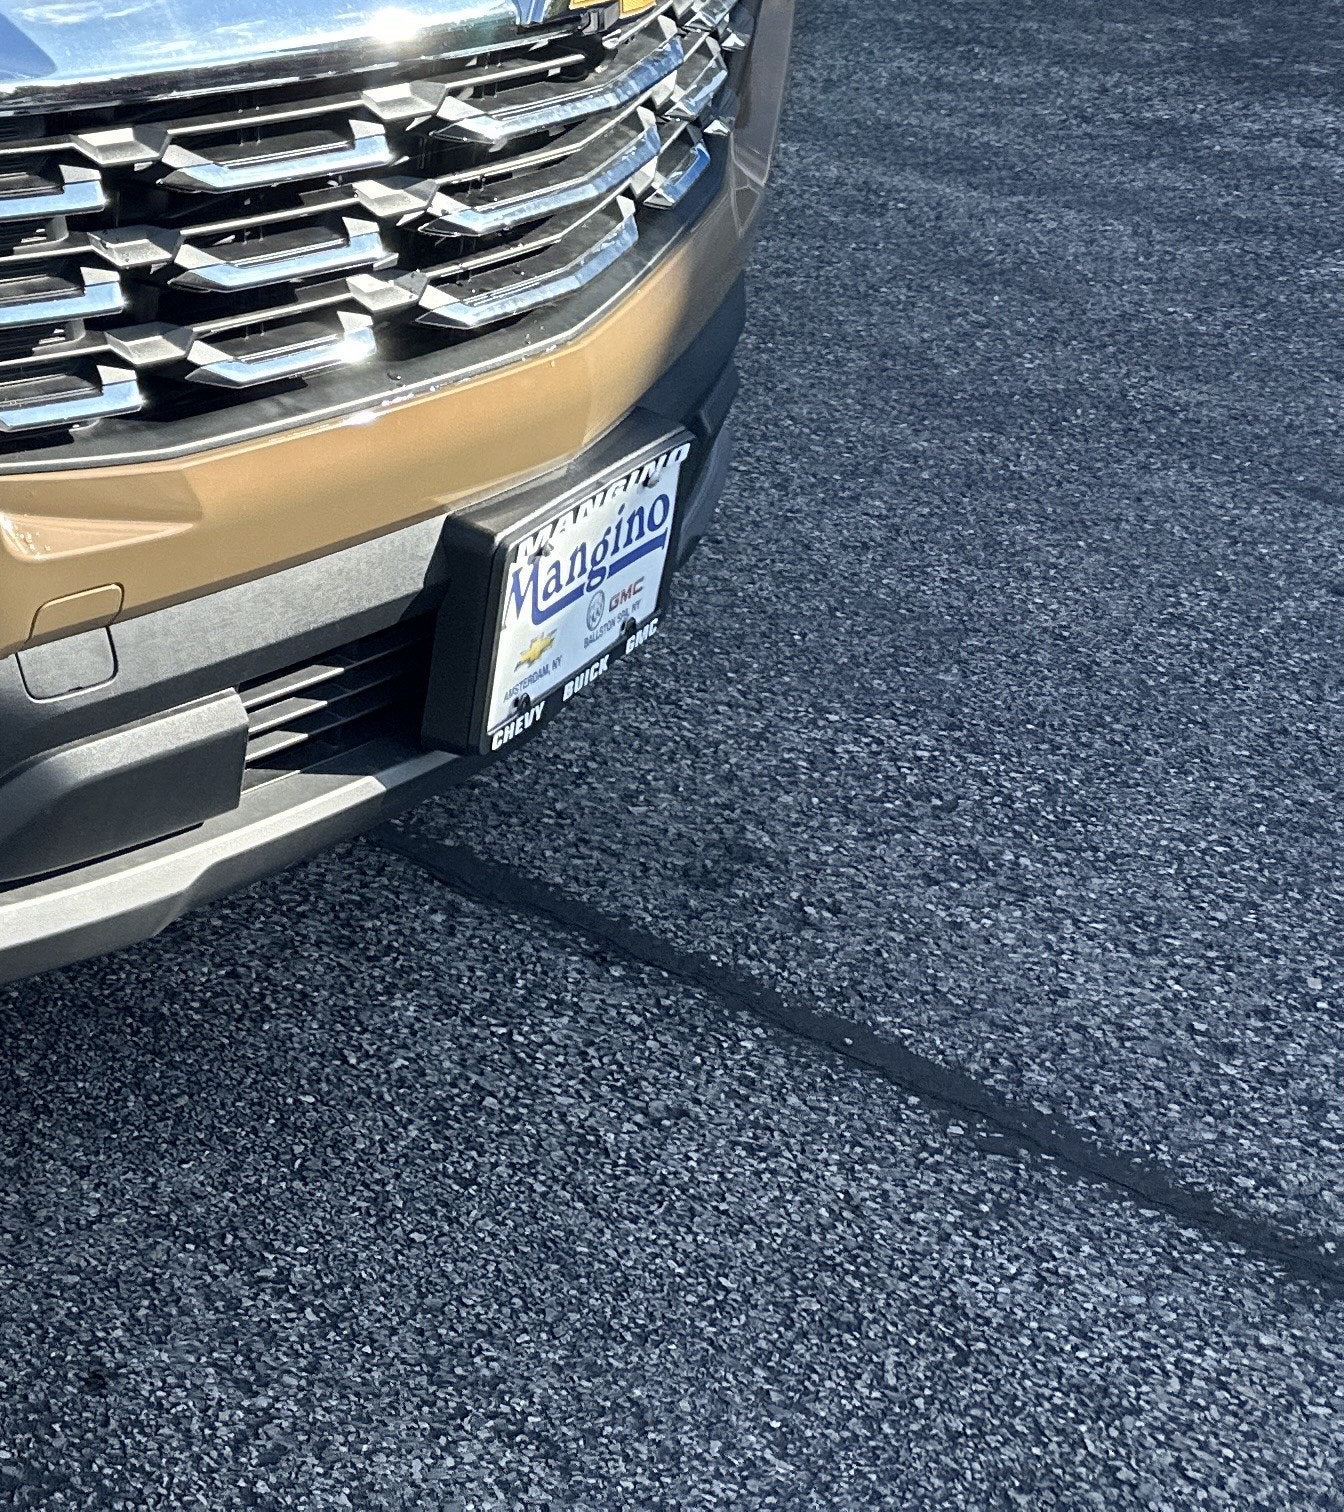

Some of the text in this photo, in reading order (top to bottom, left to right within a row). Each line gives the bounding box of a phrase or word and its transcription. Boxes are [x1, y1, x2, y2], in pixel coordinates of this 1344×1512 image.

[515, 442, 691, 561] MANGINO
[502, 493, 670, 625] Mangino
[609, 576, 645, 612] GMC
[584, 617, 616, 649] BALLSTON
[491, 617, 659, 752] CHEVY BUICK GMC
[503, 655, 562, 703] AMSTERDAM, NY
